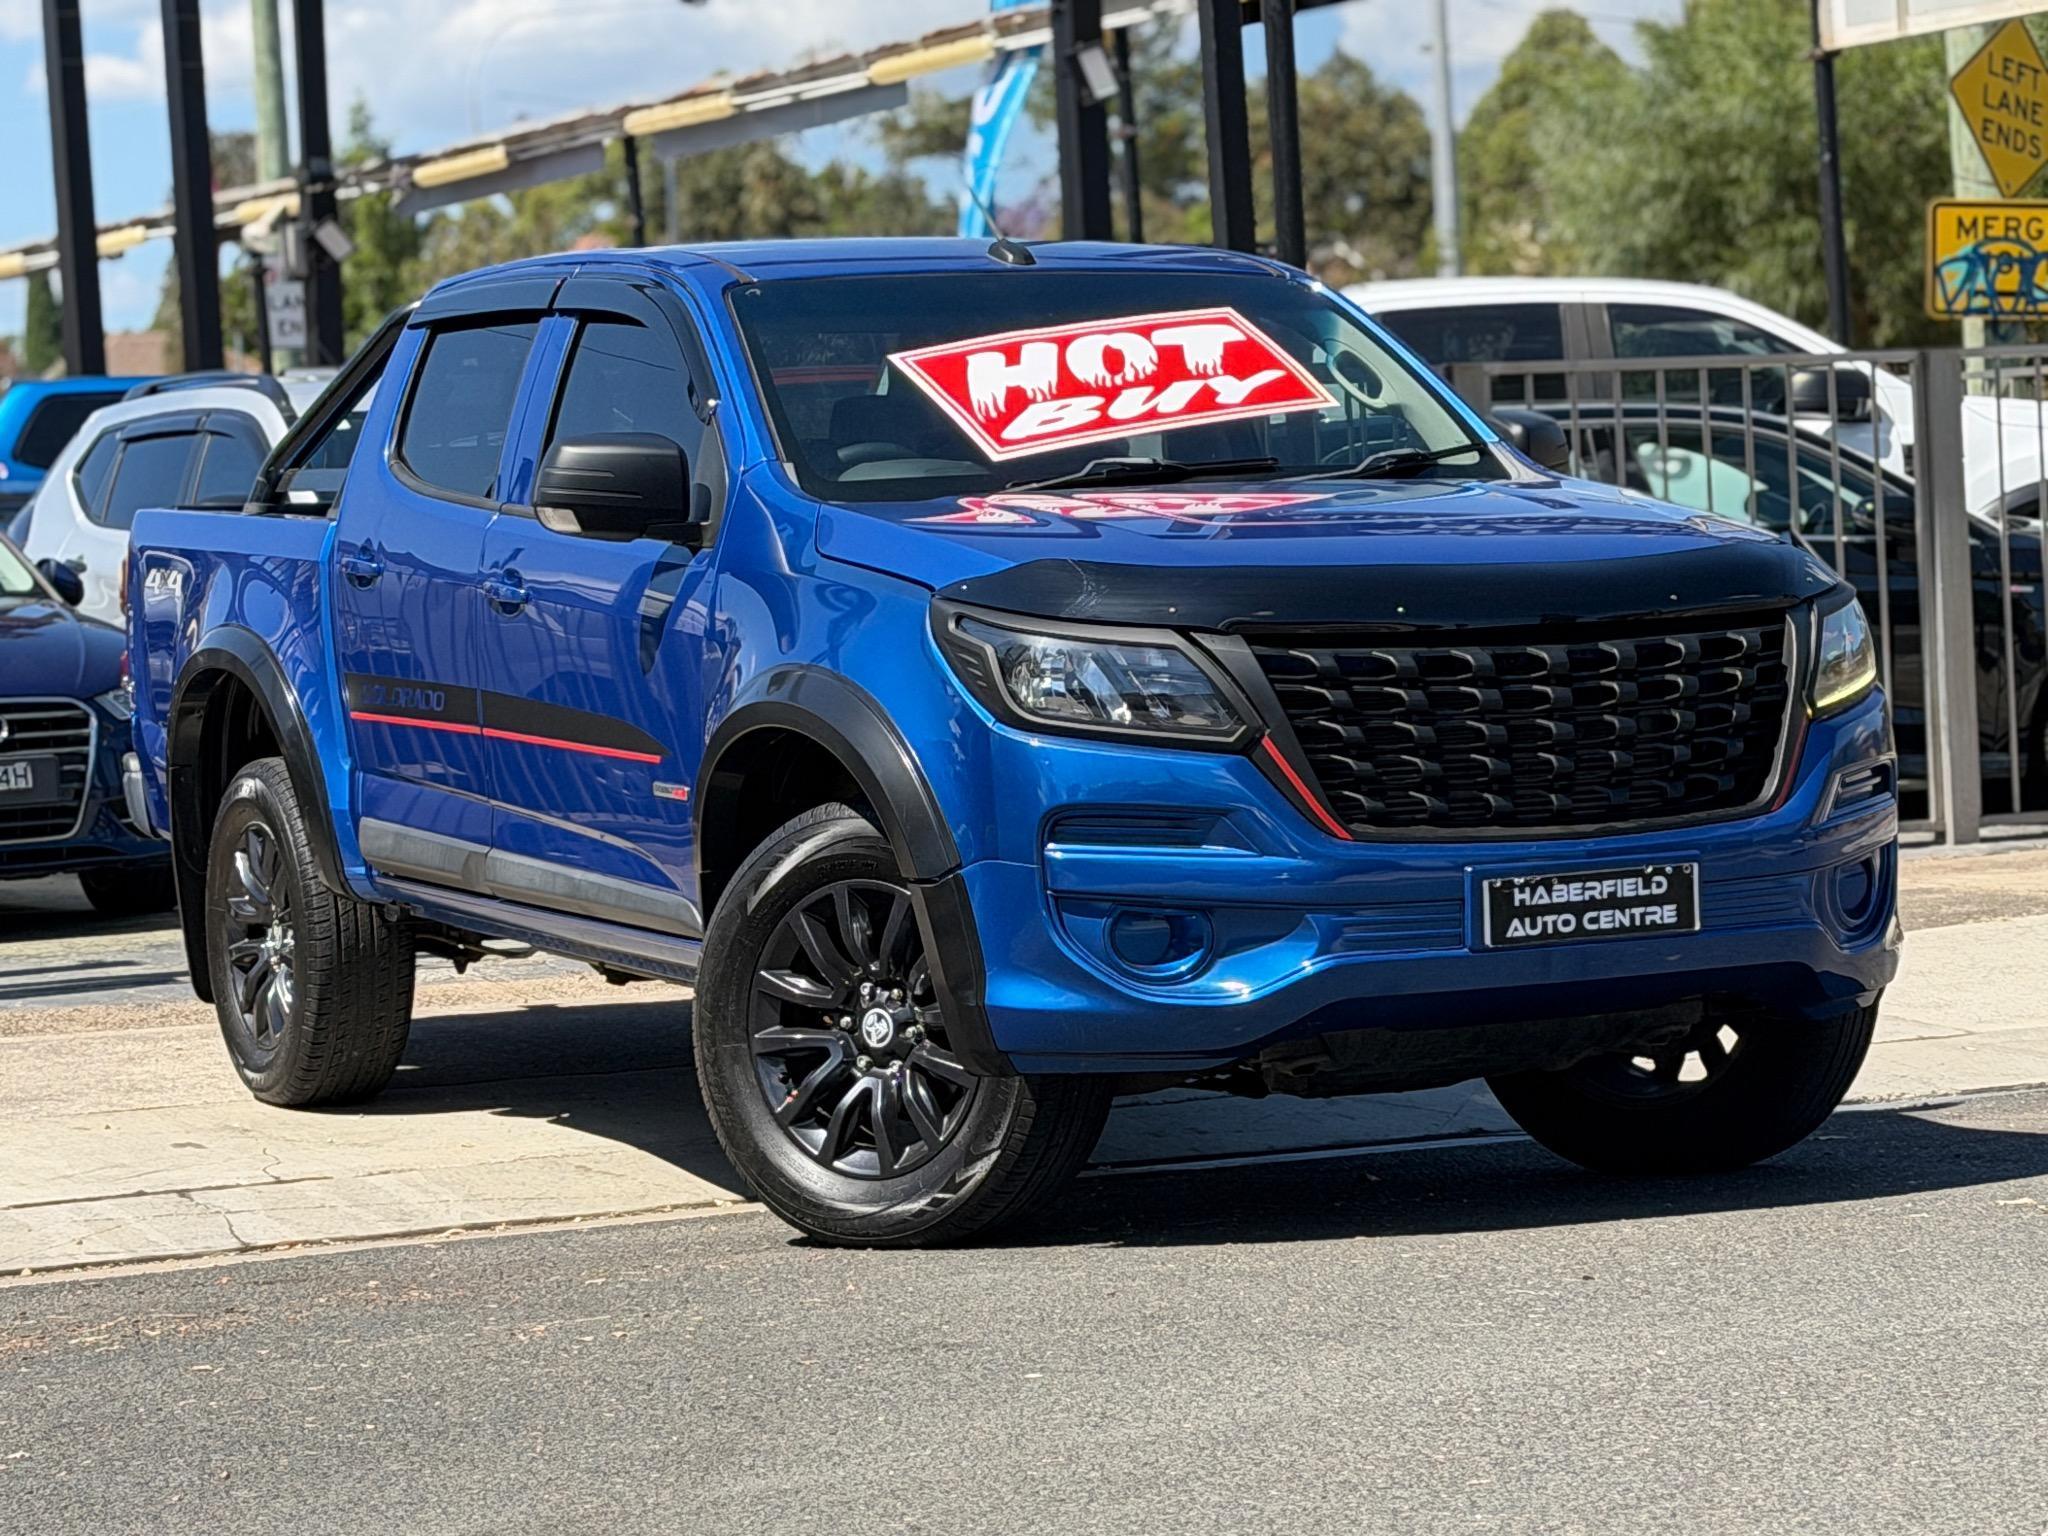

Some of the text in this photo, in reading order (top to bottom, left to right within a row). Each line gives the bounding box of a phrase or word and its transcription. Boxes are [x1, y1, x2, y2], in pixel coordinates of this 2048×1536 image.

[1987, 51, 2041, 92] LEFT
[1983, 83, 2043, 127] LANE
[1981, 117, 2042, 160] ENDS
[966, 324, 1247, 423] HOT
[1513, 875, 1669, 907] HABERFIELD
[1505, 904, 1678, 938] AUTO CENTRE
